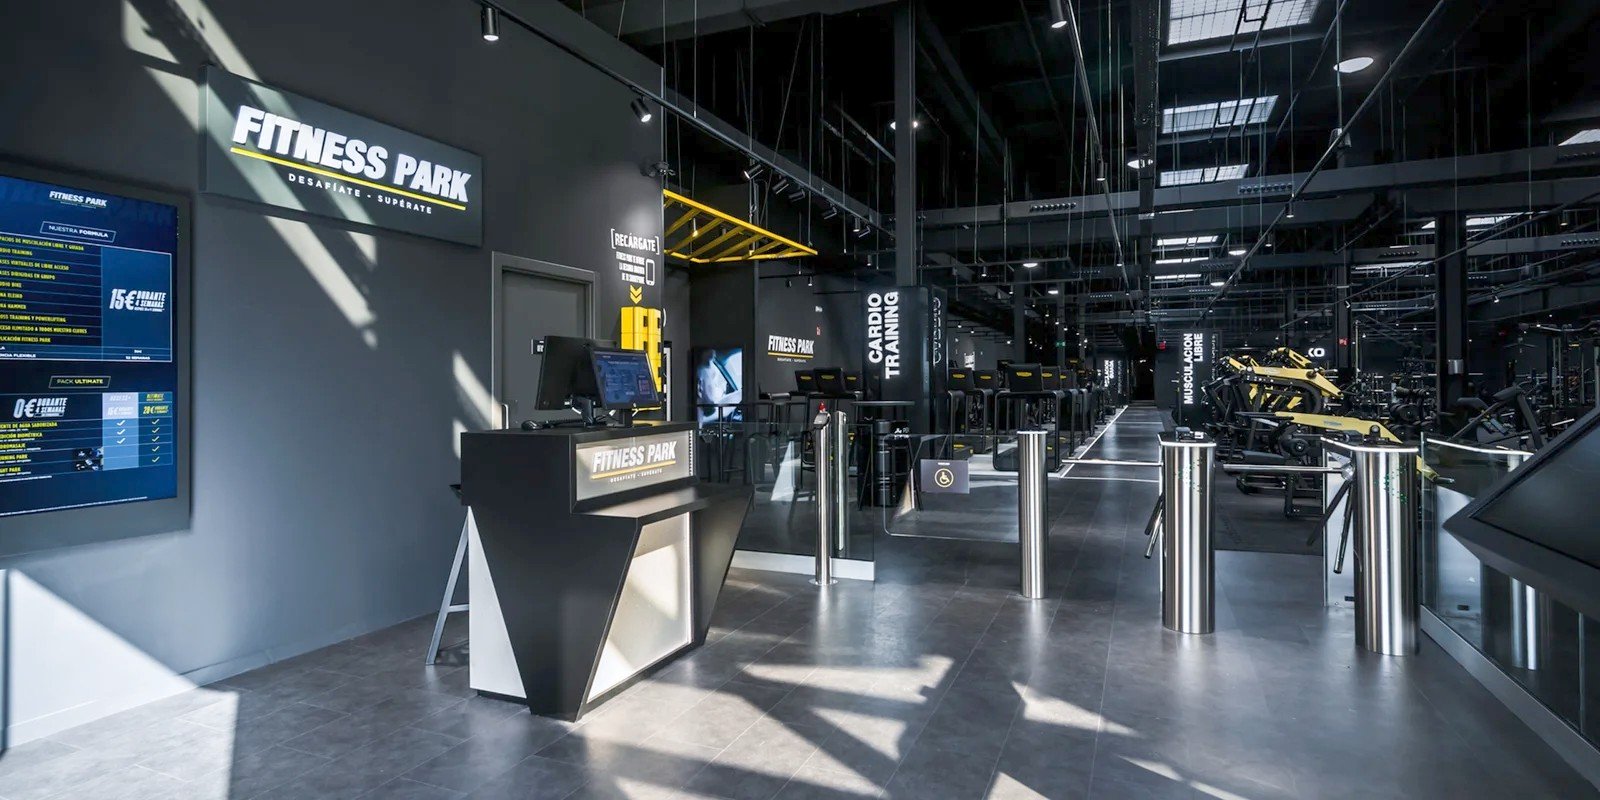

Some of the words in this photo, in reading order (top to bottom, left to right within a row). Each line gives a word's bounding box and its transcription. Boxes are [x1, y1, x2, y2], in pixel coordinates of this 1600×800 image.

[232, 105, 389, 180] FITNESS
[393, 154, 472, 203] PARK
[49, 190, 84, 202] FITNESS
[85, 196, 108, 206] PARK
[288, 173, 362, 198] DESAFÍATE
[378, 194, 432, 214] SUPÉRATE
[49, 226, 78, 234] NUESTRA
[109, 288, 137, 310] 15€
[136, 291, 166, 301] DURANTE
[868, 293, 883, 363] CARDIO
[884, 291, 899, 380] TRAINING
[768, 334, 797, 353] FITNESS
[797, 338, 814, 354] PARK
[1194, 333, 1203, 362] LIBRE
[1184, 333, 1193, 404] MUSCULACION
[13, 398, 37, 418] 0€
[37, 398, 68, 406] DURANTE
[592, 446, 644, 473] FITNESS
[647, 441, 678, 464] PARK
